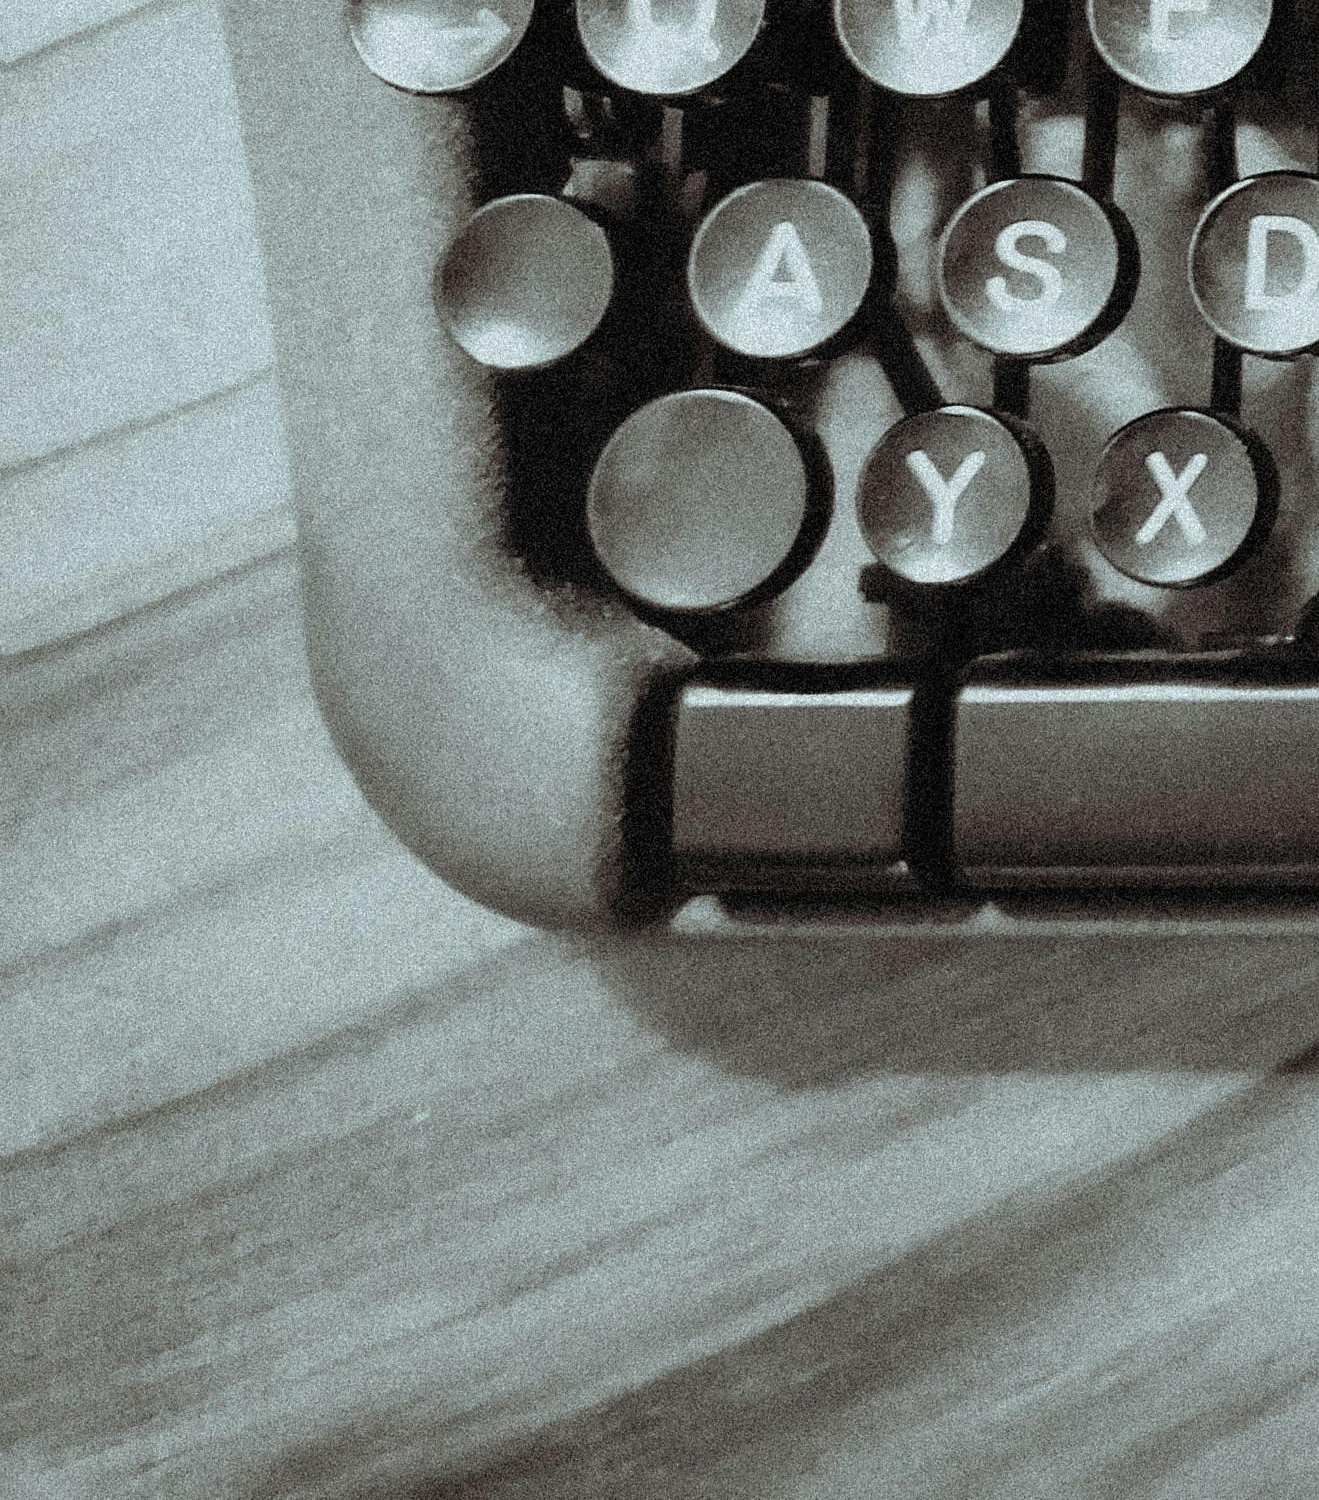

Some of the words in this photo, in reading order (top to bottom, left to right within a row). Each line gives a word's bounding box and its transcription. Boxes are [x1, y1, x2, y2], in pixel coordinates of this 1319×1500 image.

[734, 222, 822, 312] A
[985, 219, 1068, 310] S
[906, 449, 986, 545] Y
[1135, 451, 1207, 545] X
